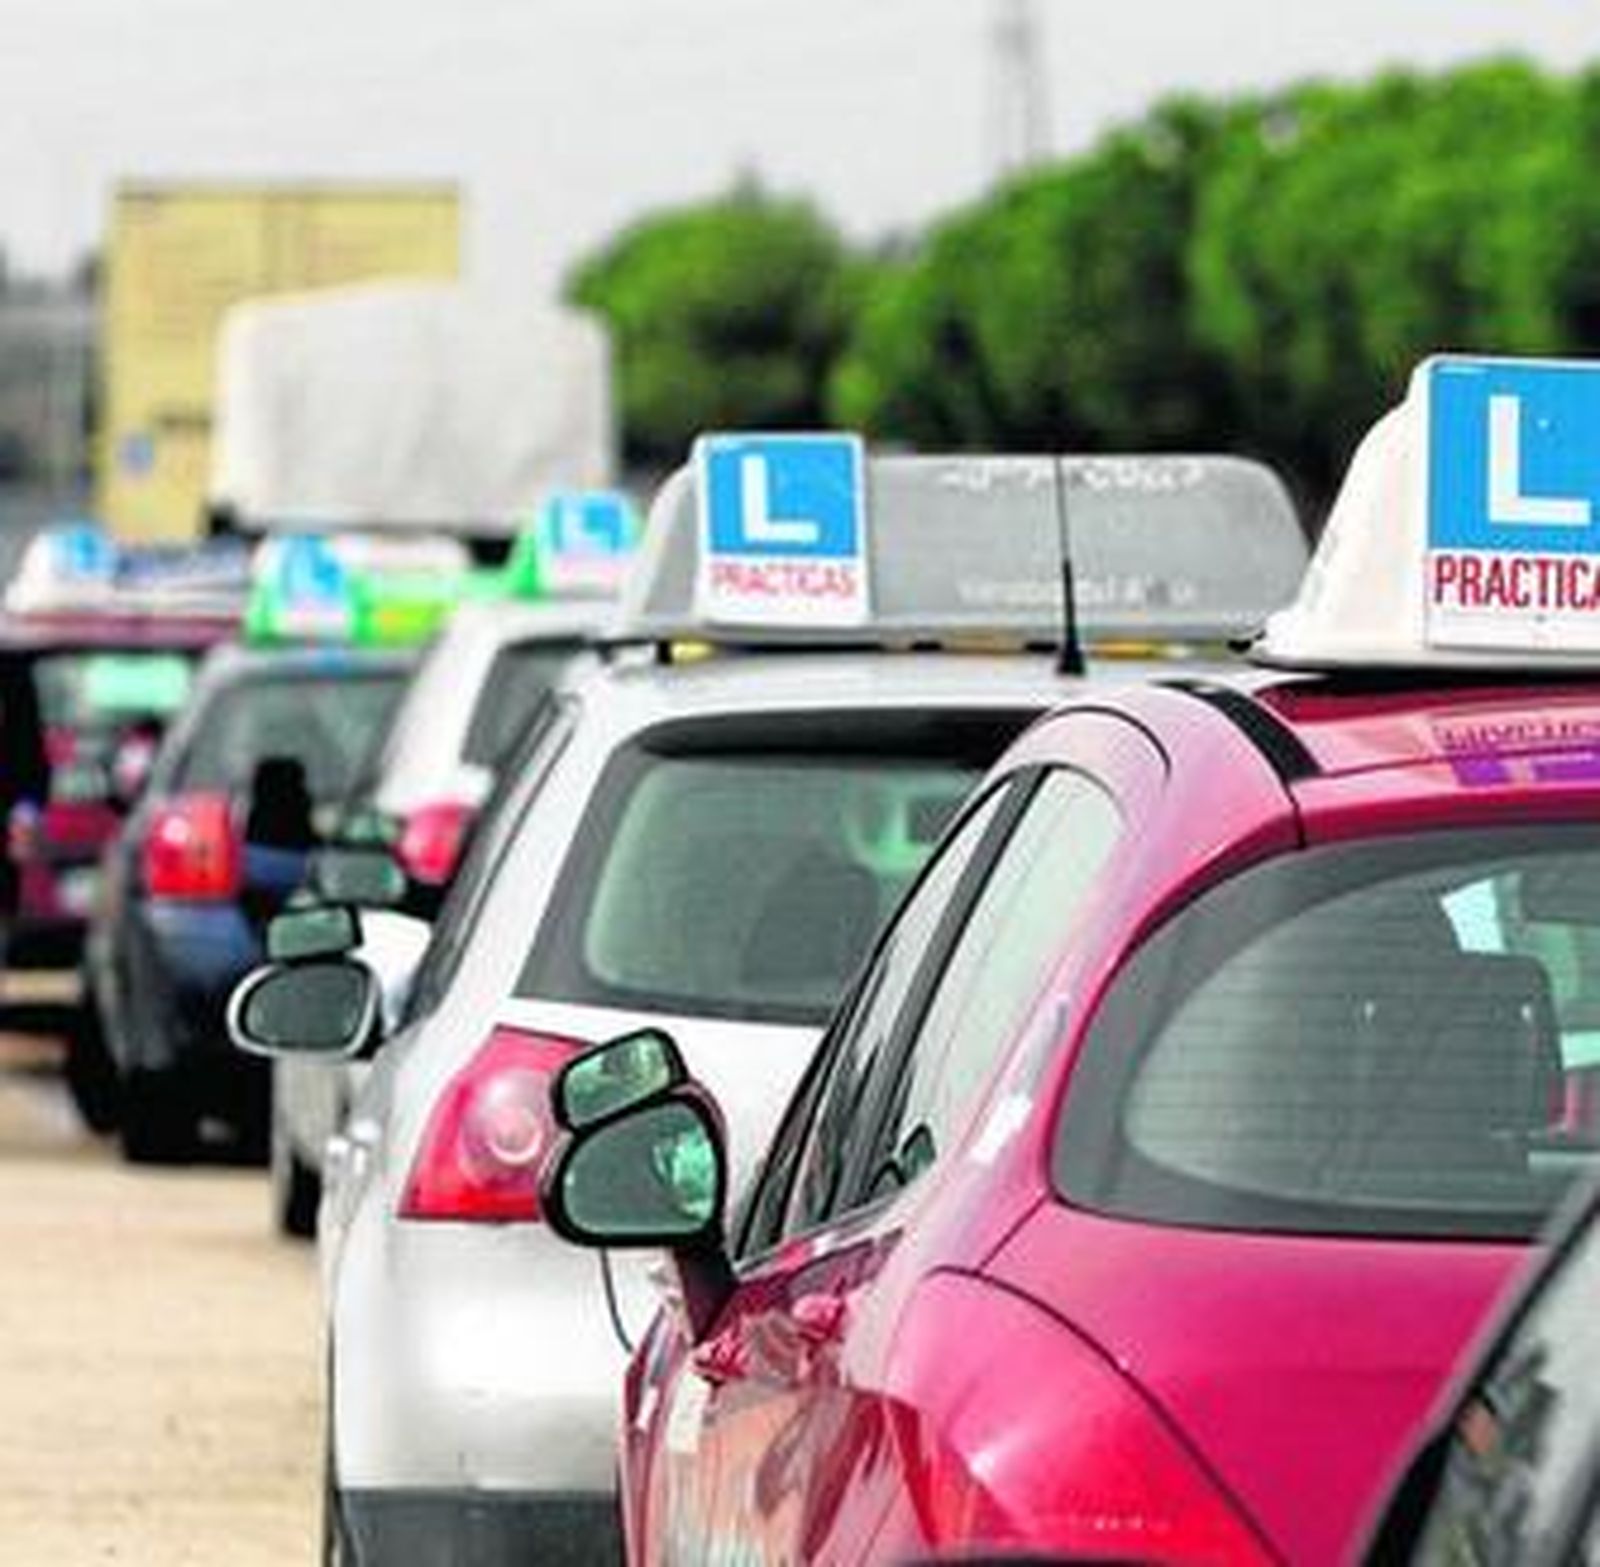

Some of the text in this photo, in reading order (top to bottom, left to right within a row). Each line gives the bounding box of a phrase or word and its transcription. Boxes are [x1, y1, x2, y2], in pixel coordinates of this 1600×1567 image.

[741, 456, 819, 544] L
[1490, 395, 1590, 526] L
[709, 563, 857, 598] PRACTICAS
